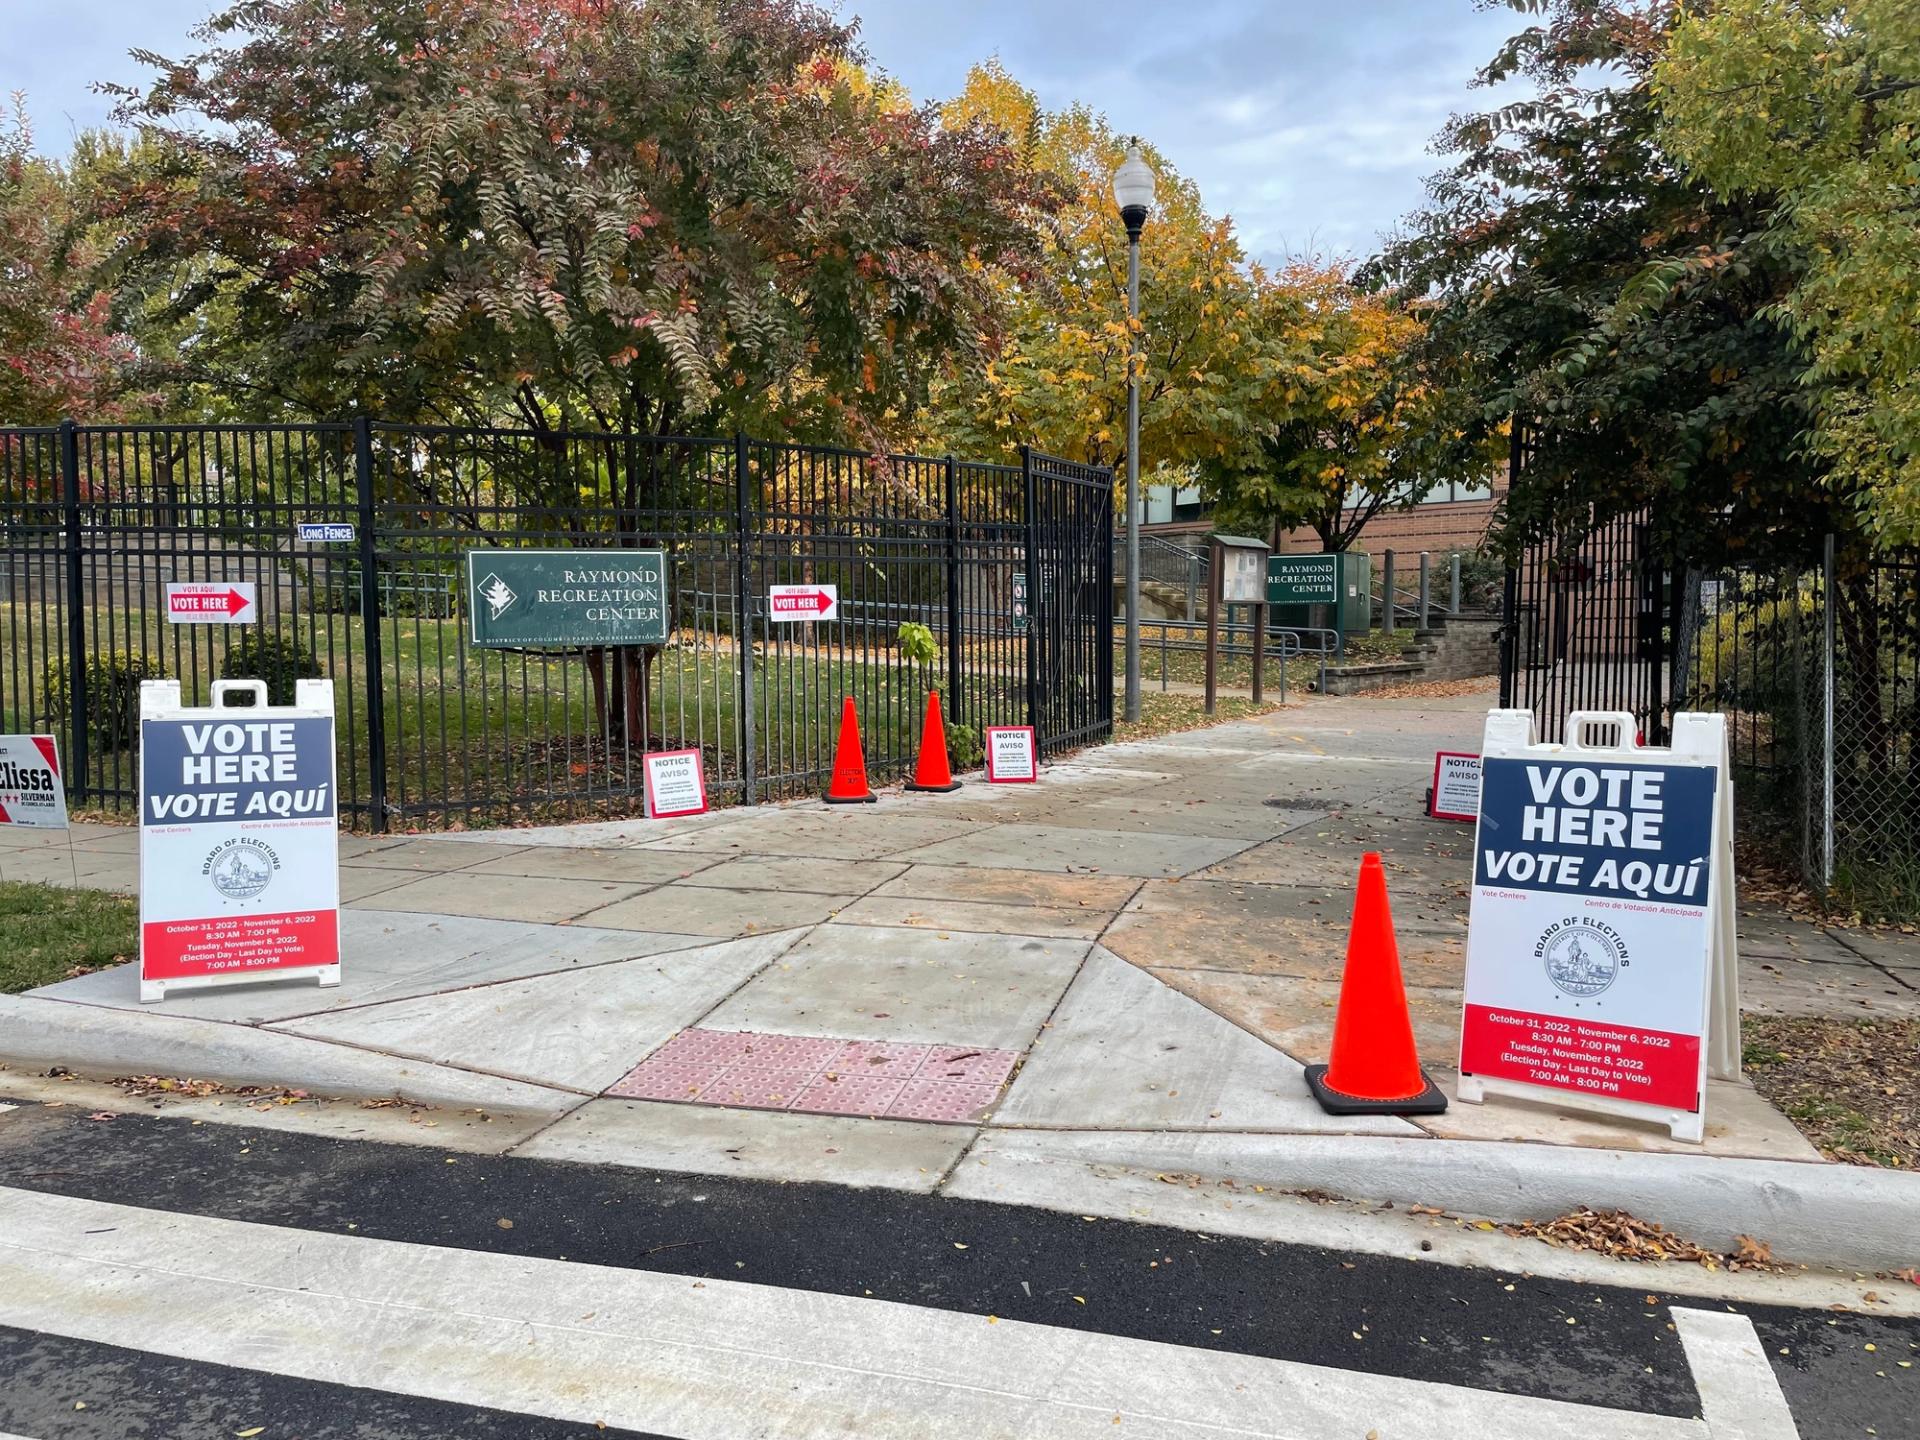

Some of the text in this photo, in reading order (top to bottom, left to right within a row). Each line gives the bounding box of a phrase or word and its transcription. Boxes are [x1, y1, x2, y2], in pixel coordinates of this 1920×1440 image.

[565, 570, 657, 583] RAYMOND
[1268, 575, 1333, 583] RECREATION
[173, 598, 228, 609] VOTE HERE
[538, 589, 658, 602] RECREATION
[775, 598, 818, 609] VOTE HERE
[586, 608, 659, 620] CENTER
[182, 724, 295, 754] VOTE
[183, 754, 297, 784] HERE
[656, 757, 690, 767] NOTICE
[660, 769, 688, 778] AVISO
[1449, 772, 1478, 780] AVISO
[1526, 766, 1665, 810] VOTE
[21, 793, 54, 801] SILVERMAN
[151, 782, 328, 819] VOTE AQUÍ
[1522, 806, 1664, 850] HERE
[202, 846, 222, 875] BOARD
[224, 839, 237, 847] OF
[241, 838, 280, 870] ELECTIONS
[1484, 850, 1703, 899] VOTE AQUÍ
[1481, 889, 1526, 900] Vote Centers
[1584, 899, 1703, 918] Centro de Votación Anticipada
[244, 918, 283, 927] November
[187, 942, 222, 951] Tuesday,
[225, 939, 264, 948] November
[277, 936, 297, 944] 2022
[1534, 917, 1629, 967] BOARD OF ELECTIONS
[180, 954, 215, 962] (Election
[217, 952, 232, 960] Day
[258, 948, 273, 956] Day
[1489, 1013, 1524, 1025] October
[1527, 1019, 1541, 1029] 31,
[1544, 1022, 1570, 1033] 2022
[1578, 1026, 1626, 1041] November
[1630, 1034, 1639, 1044] 6,
[1642, 1036, 1670, 1048] 2022
[1532, 1032, 1553, 1043] 8:30
[1556, 1036, 1572, 1046] AM
[1580, 1039, 1602, 1050] 7:00
[1605, 1043, 1621, 1053] PM
[1510, 1041, 1644, 1070] Tuesday, November 8, 2022
[1501, 1053, 1540, 1067] (Election
[1543, 1059, 1561, 1070] Day
[1569, 1064, 1589, 1075] Last
[1592, 1067, 1610, 1079] Day
[1612, 1070, 1623, 1080] to
[1625, 1072, 1651, 1085] Vote)
[1530, 1070, 1551, 1080] 7:00
[1553, 1073, 1569, 1084] AM
[1577, 1077, 1600, 1088] 8:00
[1603, 1081, 1619, 1092] PM
